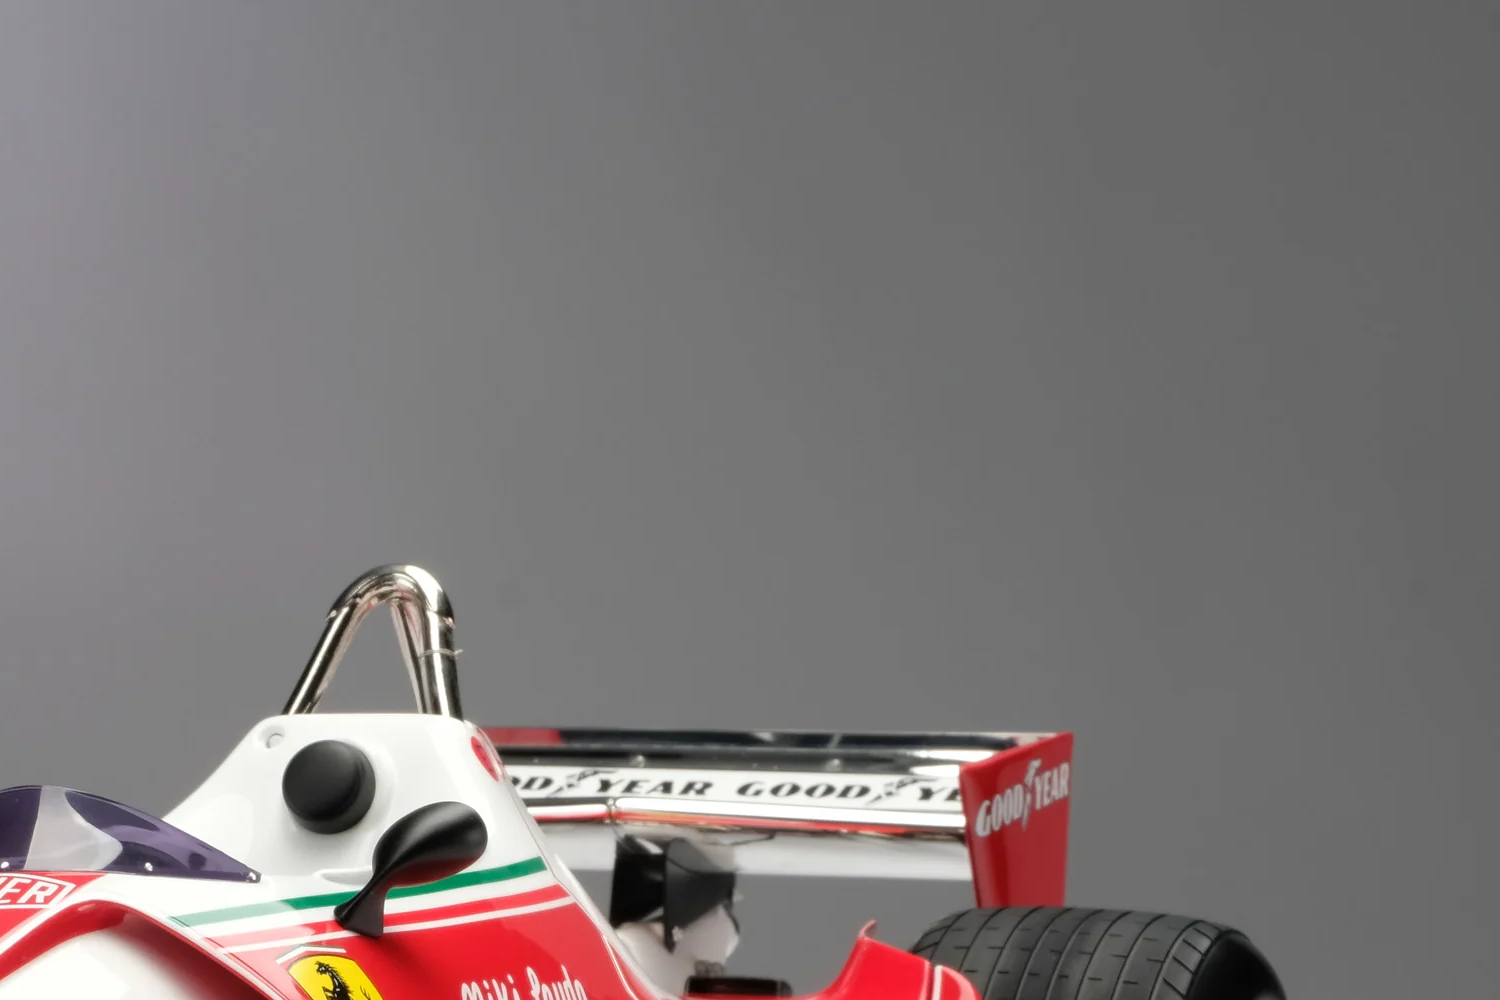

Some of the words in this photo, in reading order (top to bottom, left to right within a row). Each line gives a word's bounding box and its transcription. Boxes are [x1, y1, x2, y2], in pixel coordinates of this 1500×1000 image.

[597, 778, 714, 796] YEAR
[736, 781, 872, 800] GOOD
[975, 784, 1024, 837] GOOD
[1035, 762, 1070, 812] YEAR
